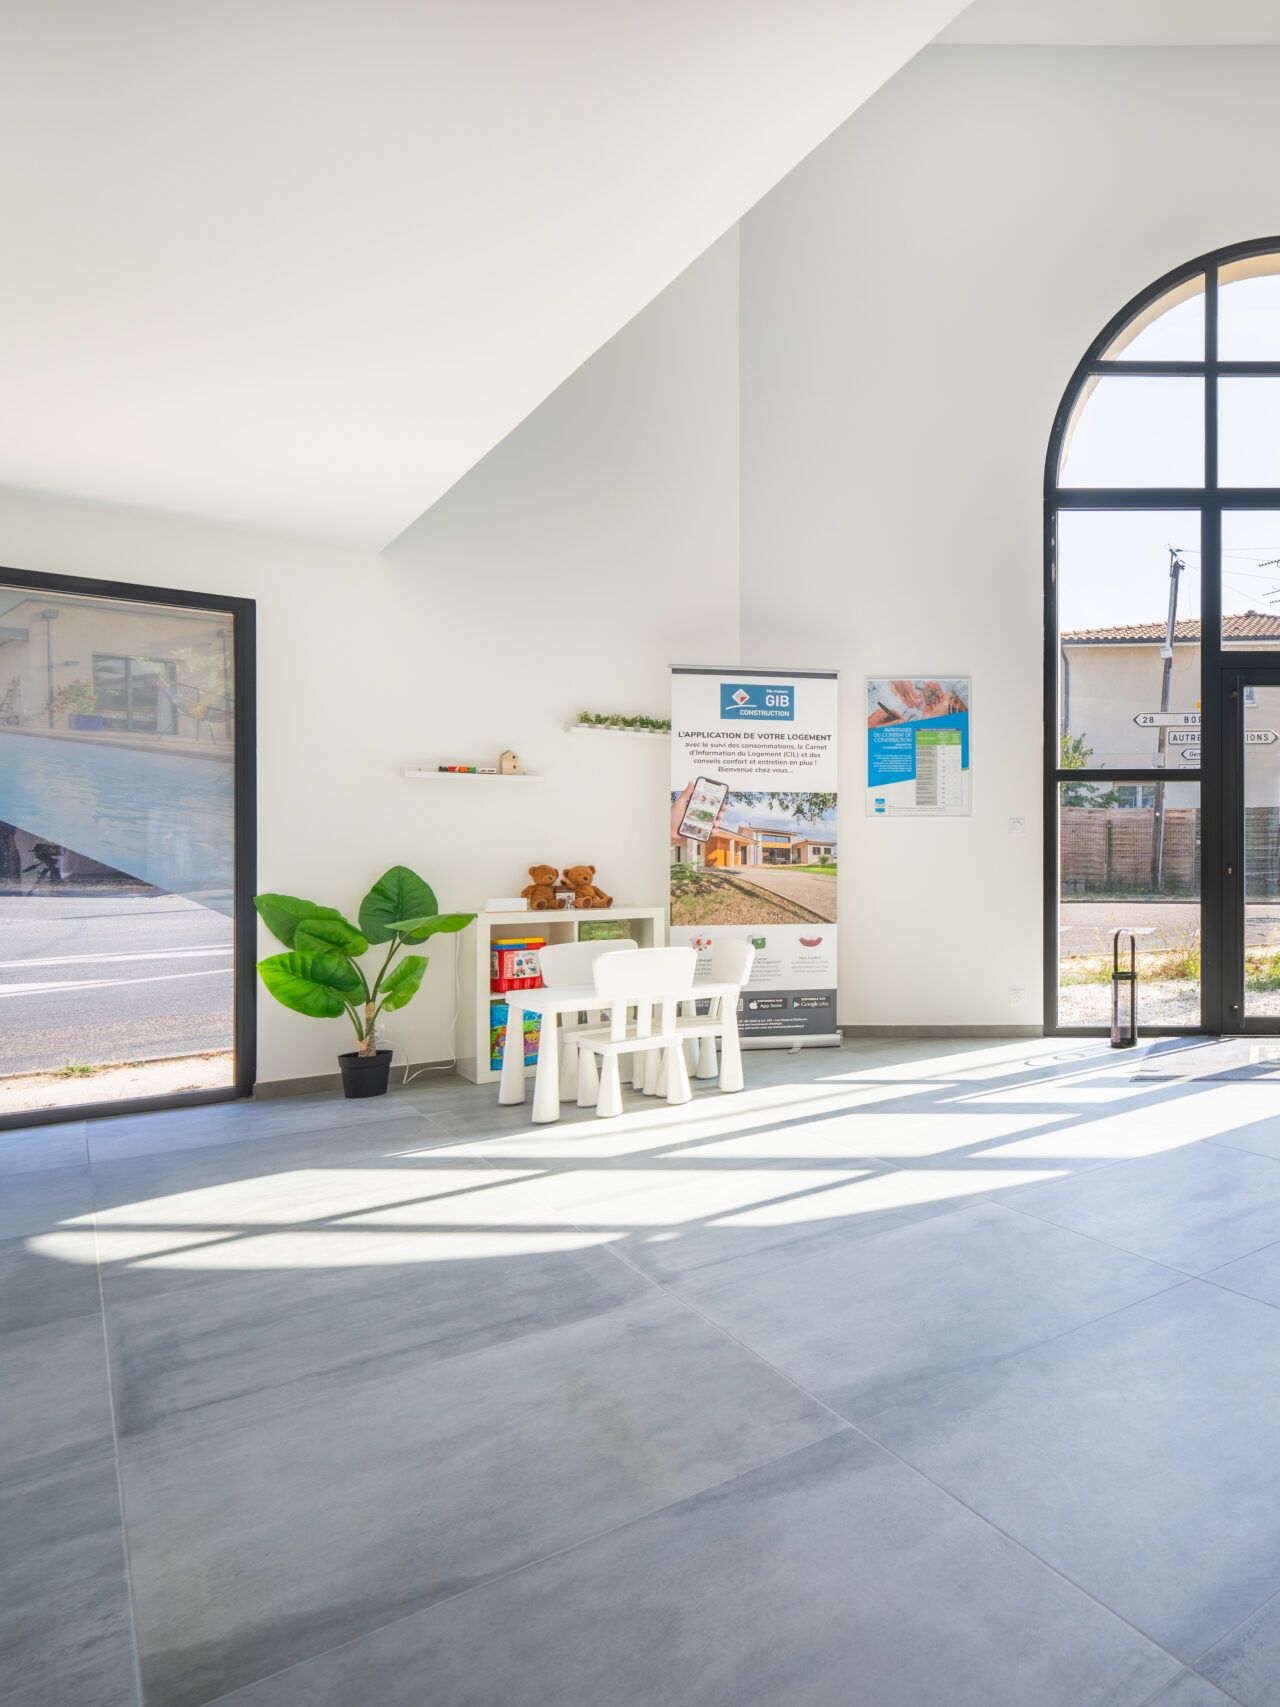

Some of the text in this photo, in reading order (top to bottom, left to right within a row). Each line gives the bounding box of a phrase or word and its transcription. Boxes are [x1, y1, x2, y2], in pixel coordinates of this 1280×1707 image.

[765, 694, 790, 707] GIB
[739, 709, 790, 717] CONSTRUCTION
[1142, 716, 1154, 724] 28
[678, 731, 741, 739] L'APPLICATION
